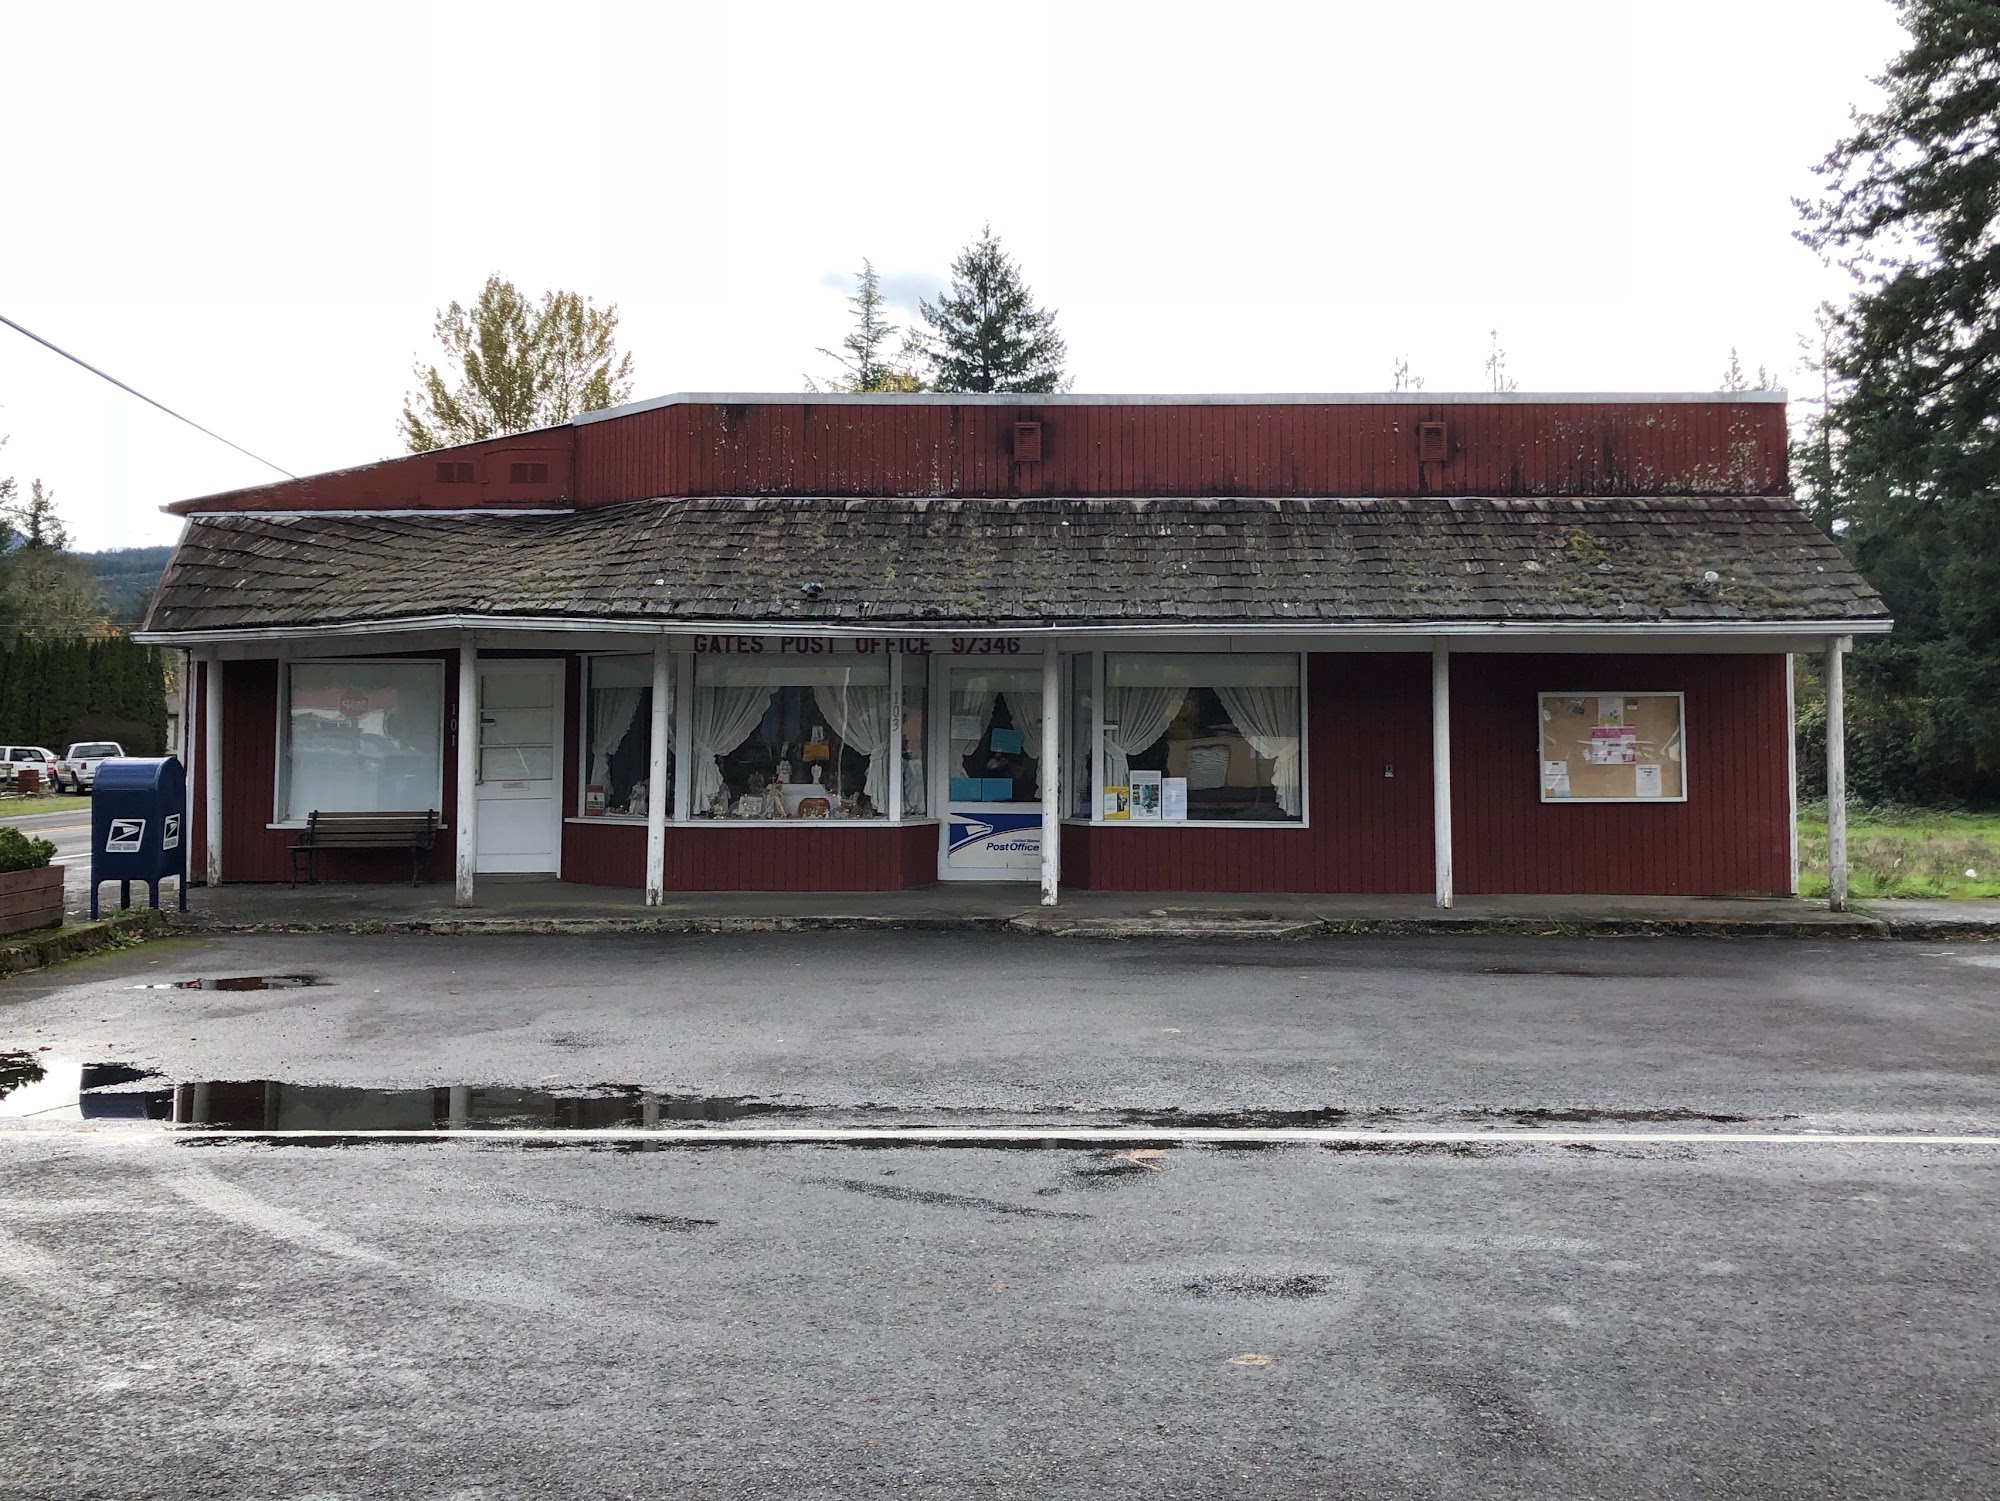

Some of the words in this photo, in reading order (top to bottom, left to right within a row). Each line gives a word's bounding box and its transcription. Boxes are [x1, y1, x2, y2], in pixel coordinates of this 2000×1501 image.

[693, 635, 765, 654] GATES
[781, 636, 834, 654] POST
[855, 637, 933, 655] OFFICE
[951, 637, 1021, 655] 97346
[450, 703, 458, 747] 101
[892, 691, 900, 732] 103
[986, 842, 1009, 851] Post
[1010, 842, 1040, 851] Office
